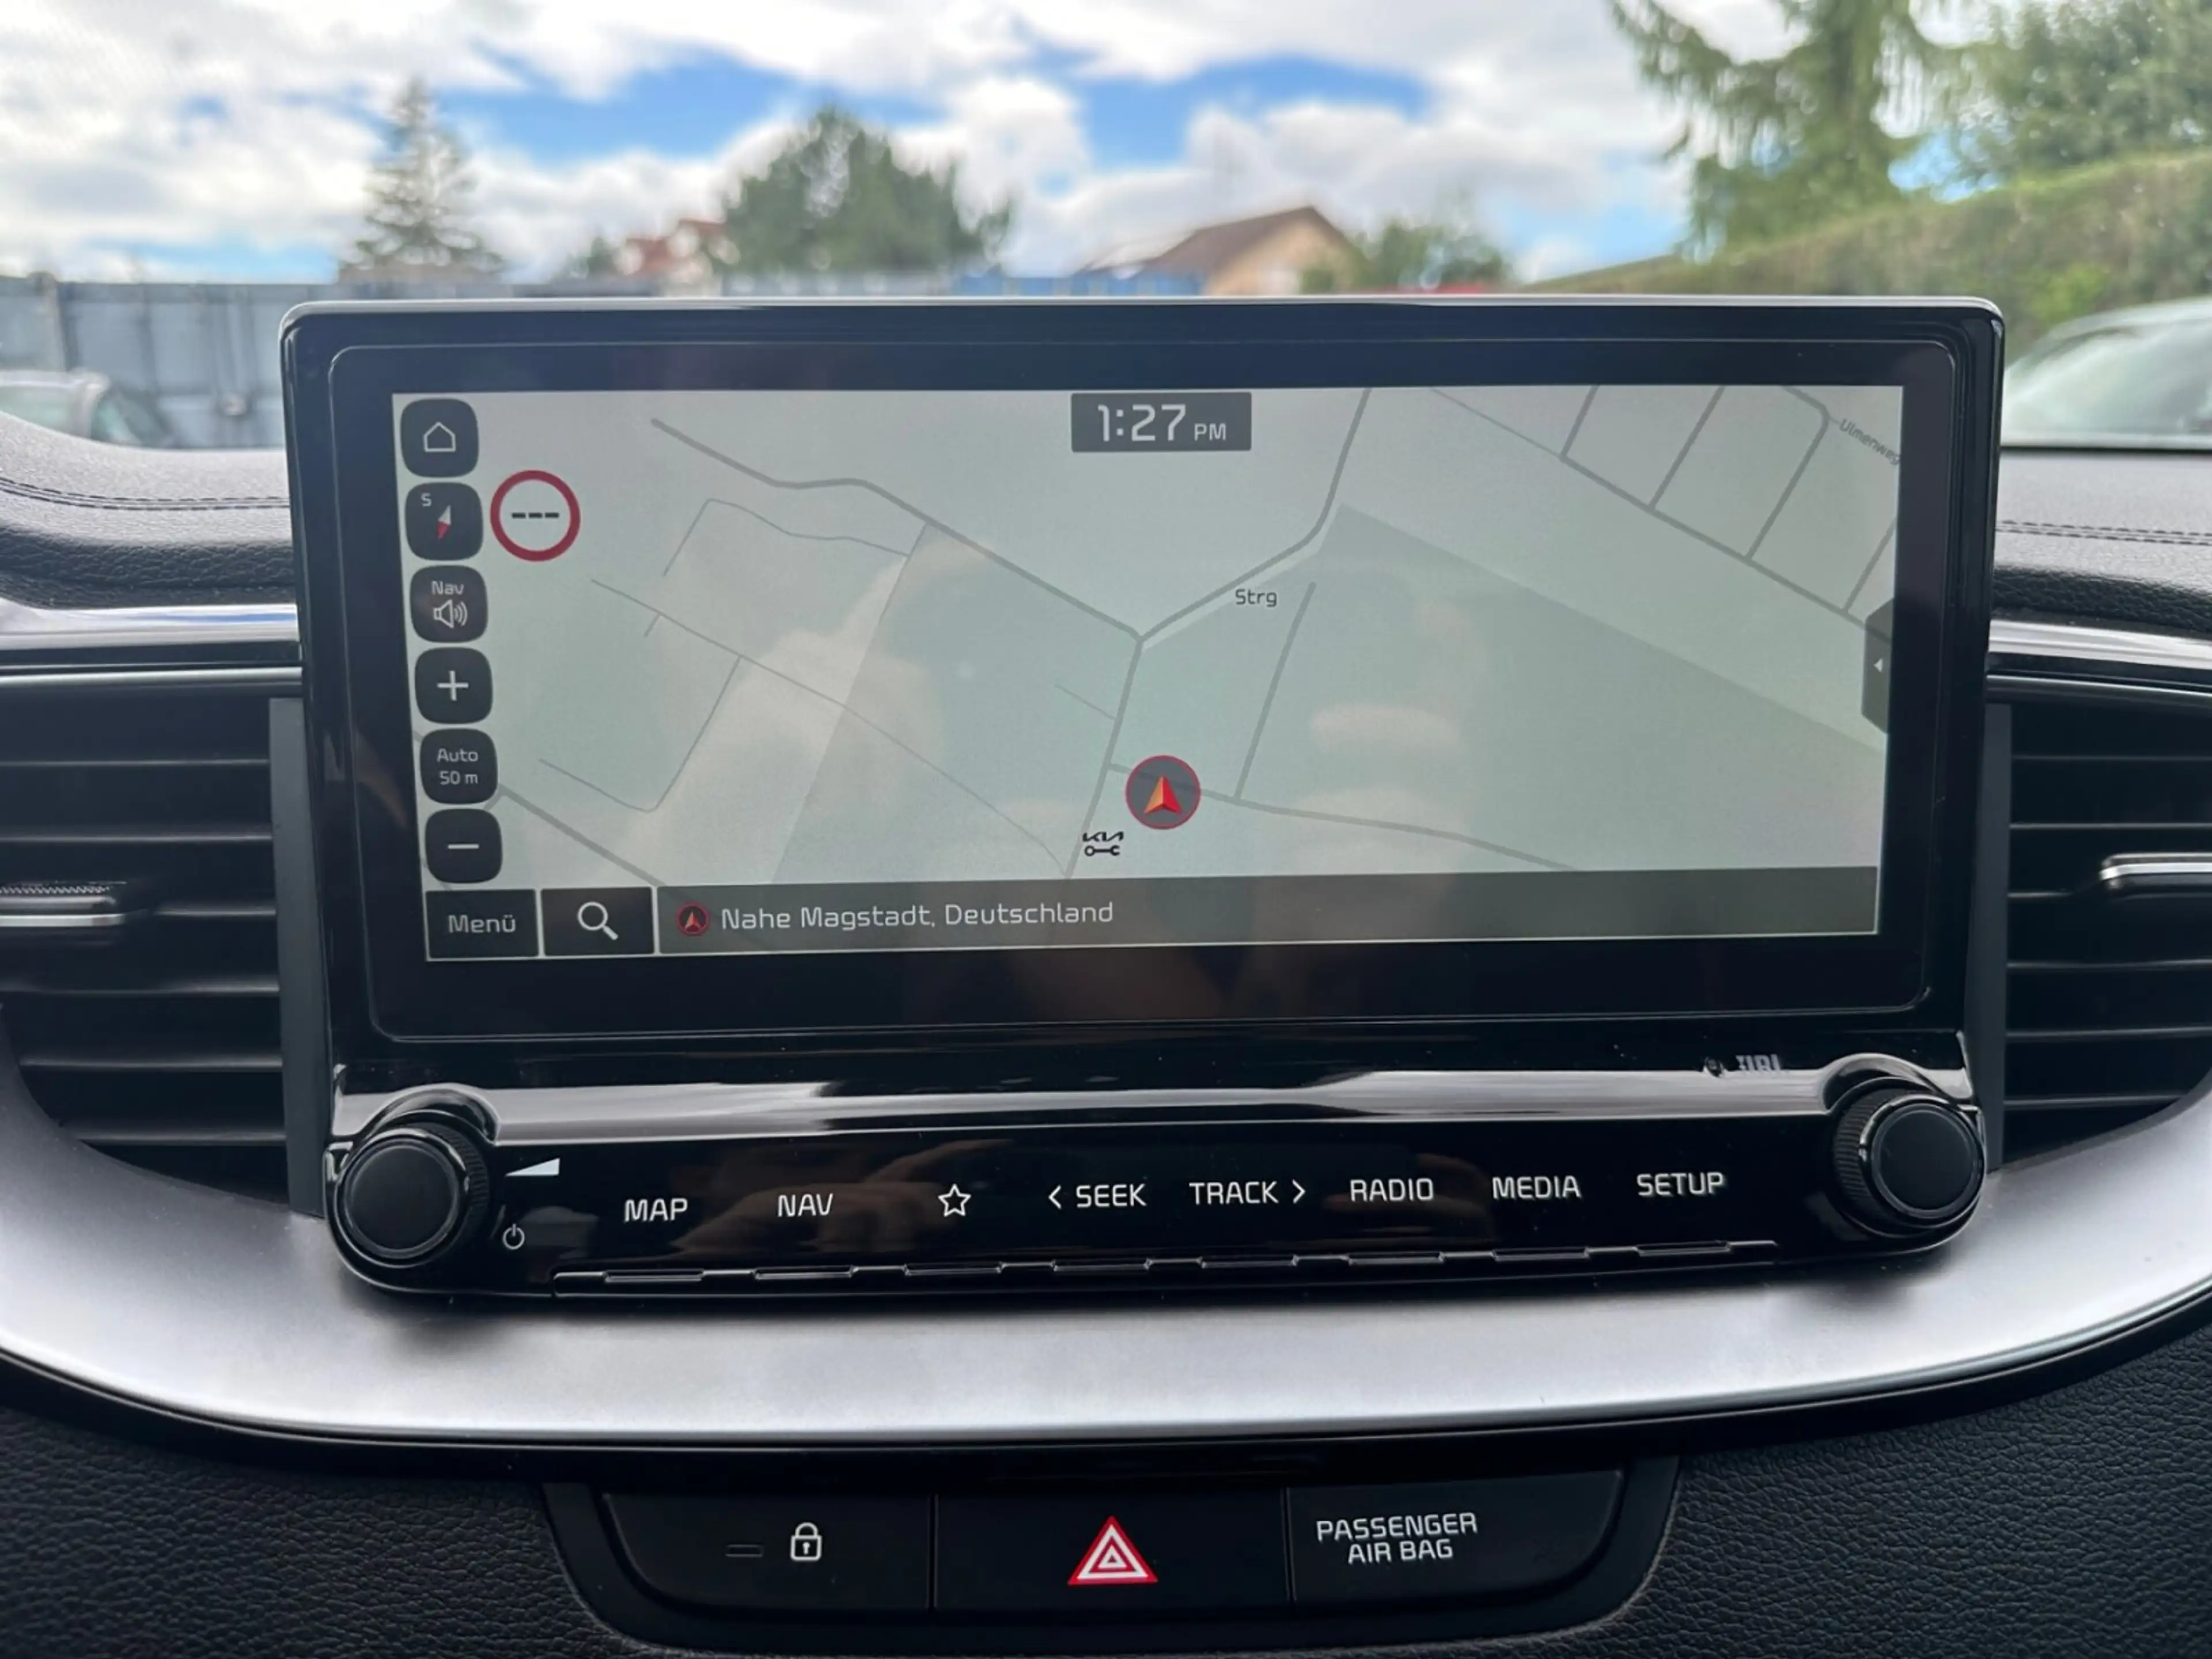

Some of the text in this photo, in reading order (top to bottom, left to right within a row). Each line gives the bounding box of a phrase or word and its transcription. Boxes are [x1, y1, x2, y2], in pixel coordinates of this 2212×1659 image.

[1098, 403, 1227, 442] 1:27 PM
[421, 494, 432, 507] S
[431, 581, 464, 596] Nav
[1235, 588, 1278, 607] Strg
[437, 748, 479, 763] Auto
[439, 771, 478, 785] 50 m
[448, 914, 516, 933] Menü
[721, 908, 791, 930] Nahe
[945, 902, 1113, 926] Deutschland
[1075, 1183, 1147, 1208] SEEK
[1188, 1181, 1279, 1205] TRACK
[1350, 1178, 1434, 1202] RADIO
[1492, 1176, 1582, 1199] MEDIA
[1636, 1172, 1725, 1196] SETUP
[623, 1198, 688, 1223] MAP
[777, 1194, 834, 1218] NAV
[1316, 1512, 1478, 1542] PASSENGER
[1347, 1539, 1454, 1566] AIR BAG
